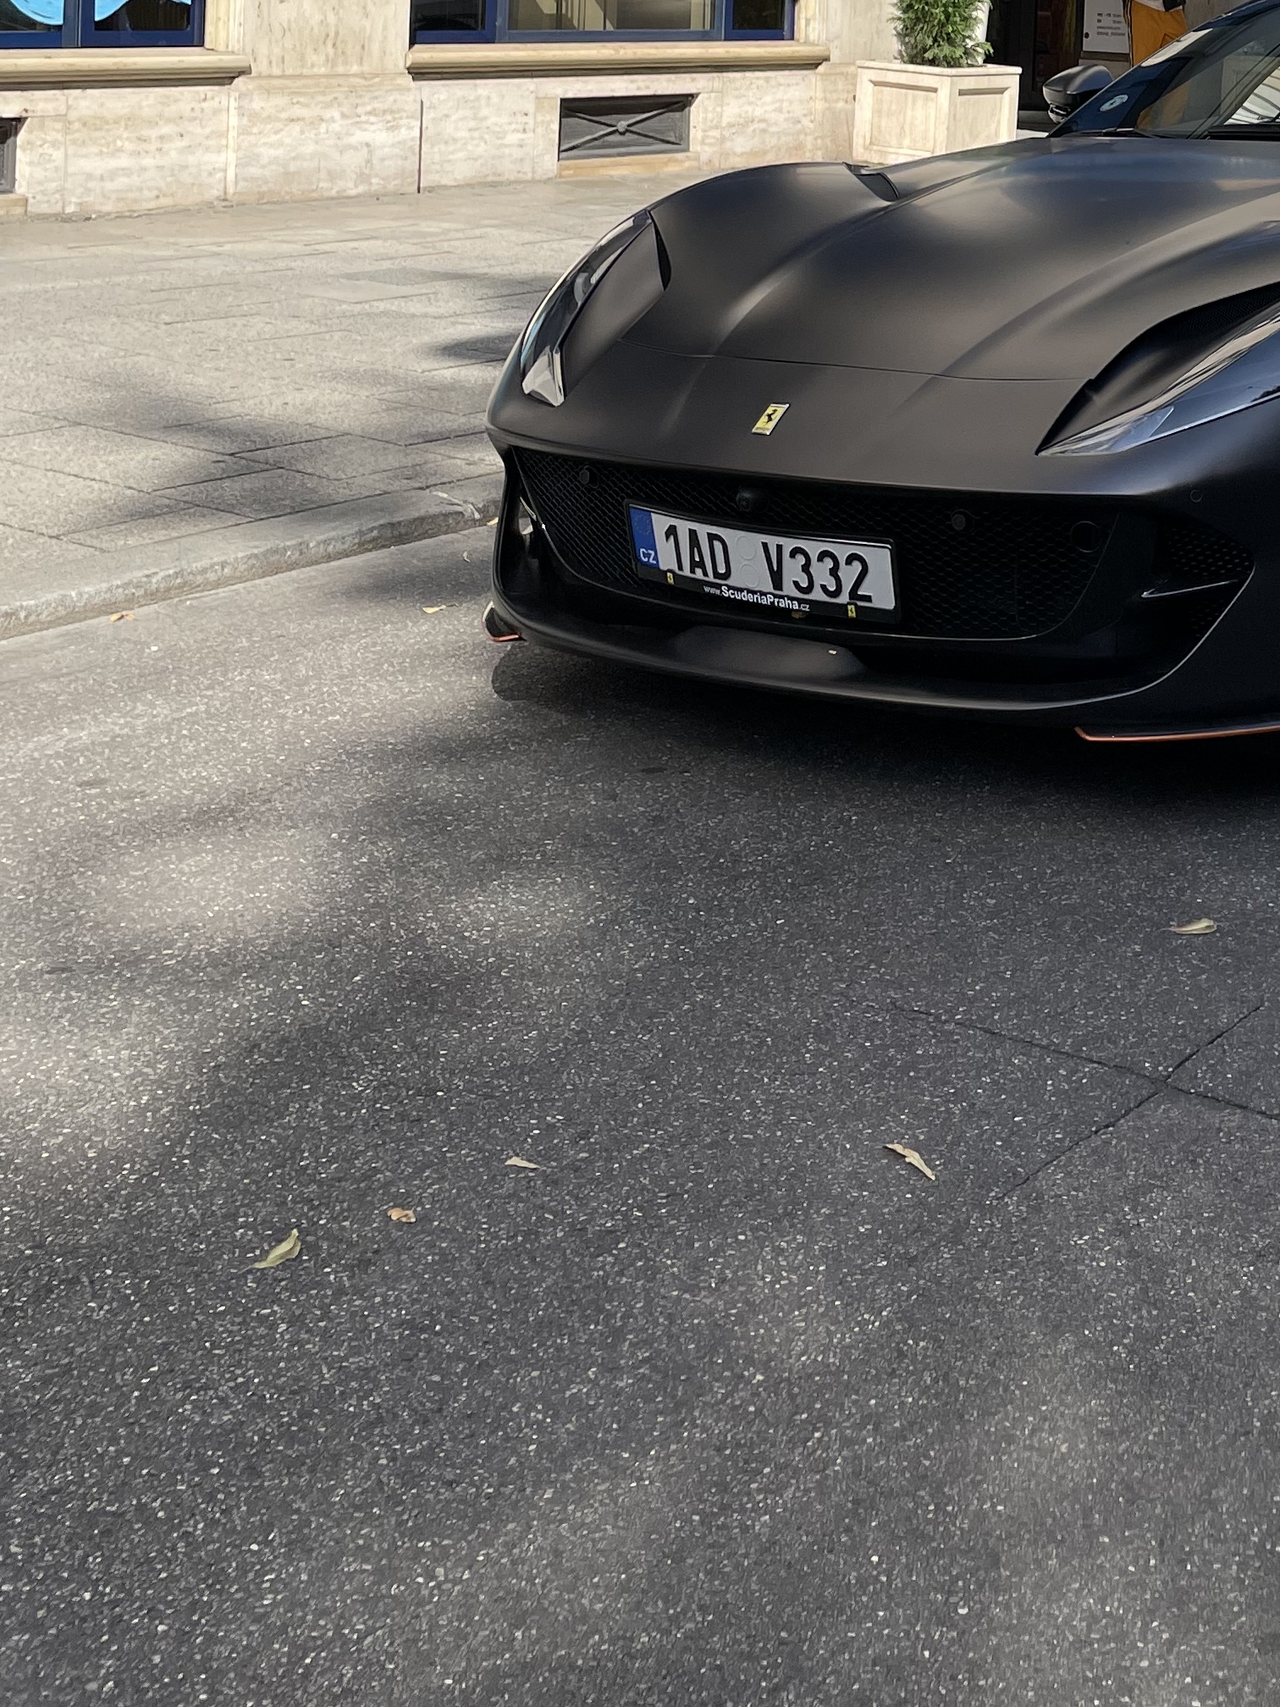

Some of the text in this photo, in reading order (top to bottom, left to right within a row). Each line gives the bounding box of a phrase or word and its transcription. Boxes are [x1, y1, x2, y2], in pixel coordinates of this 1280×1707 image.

[639, 548, 657, 564] CZ
[664, 524, 873, 604] 1AD V332
[703, 585, 810, 612] www.ScuderiaPraha.cz
